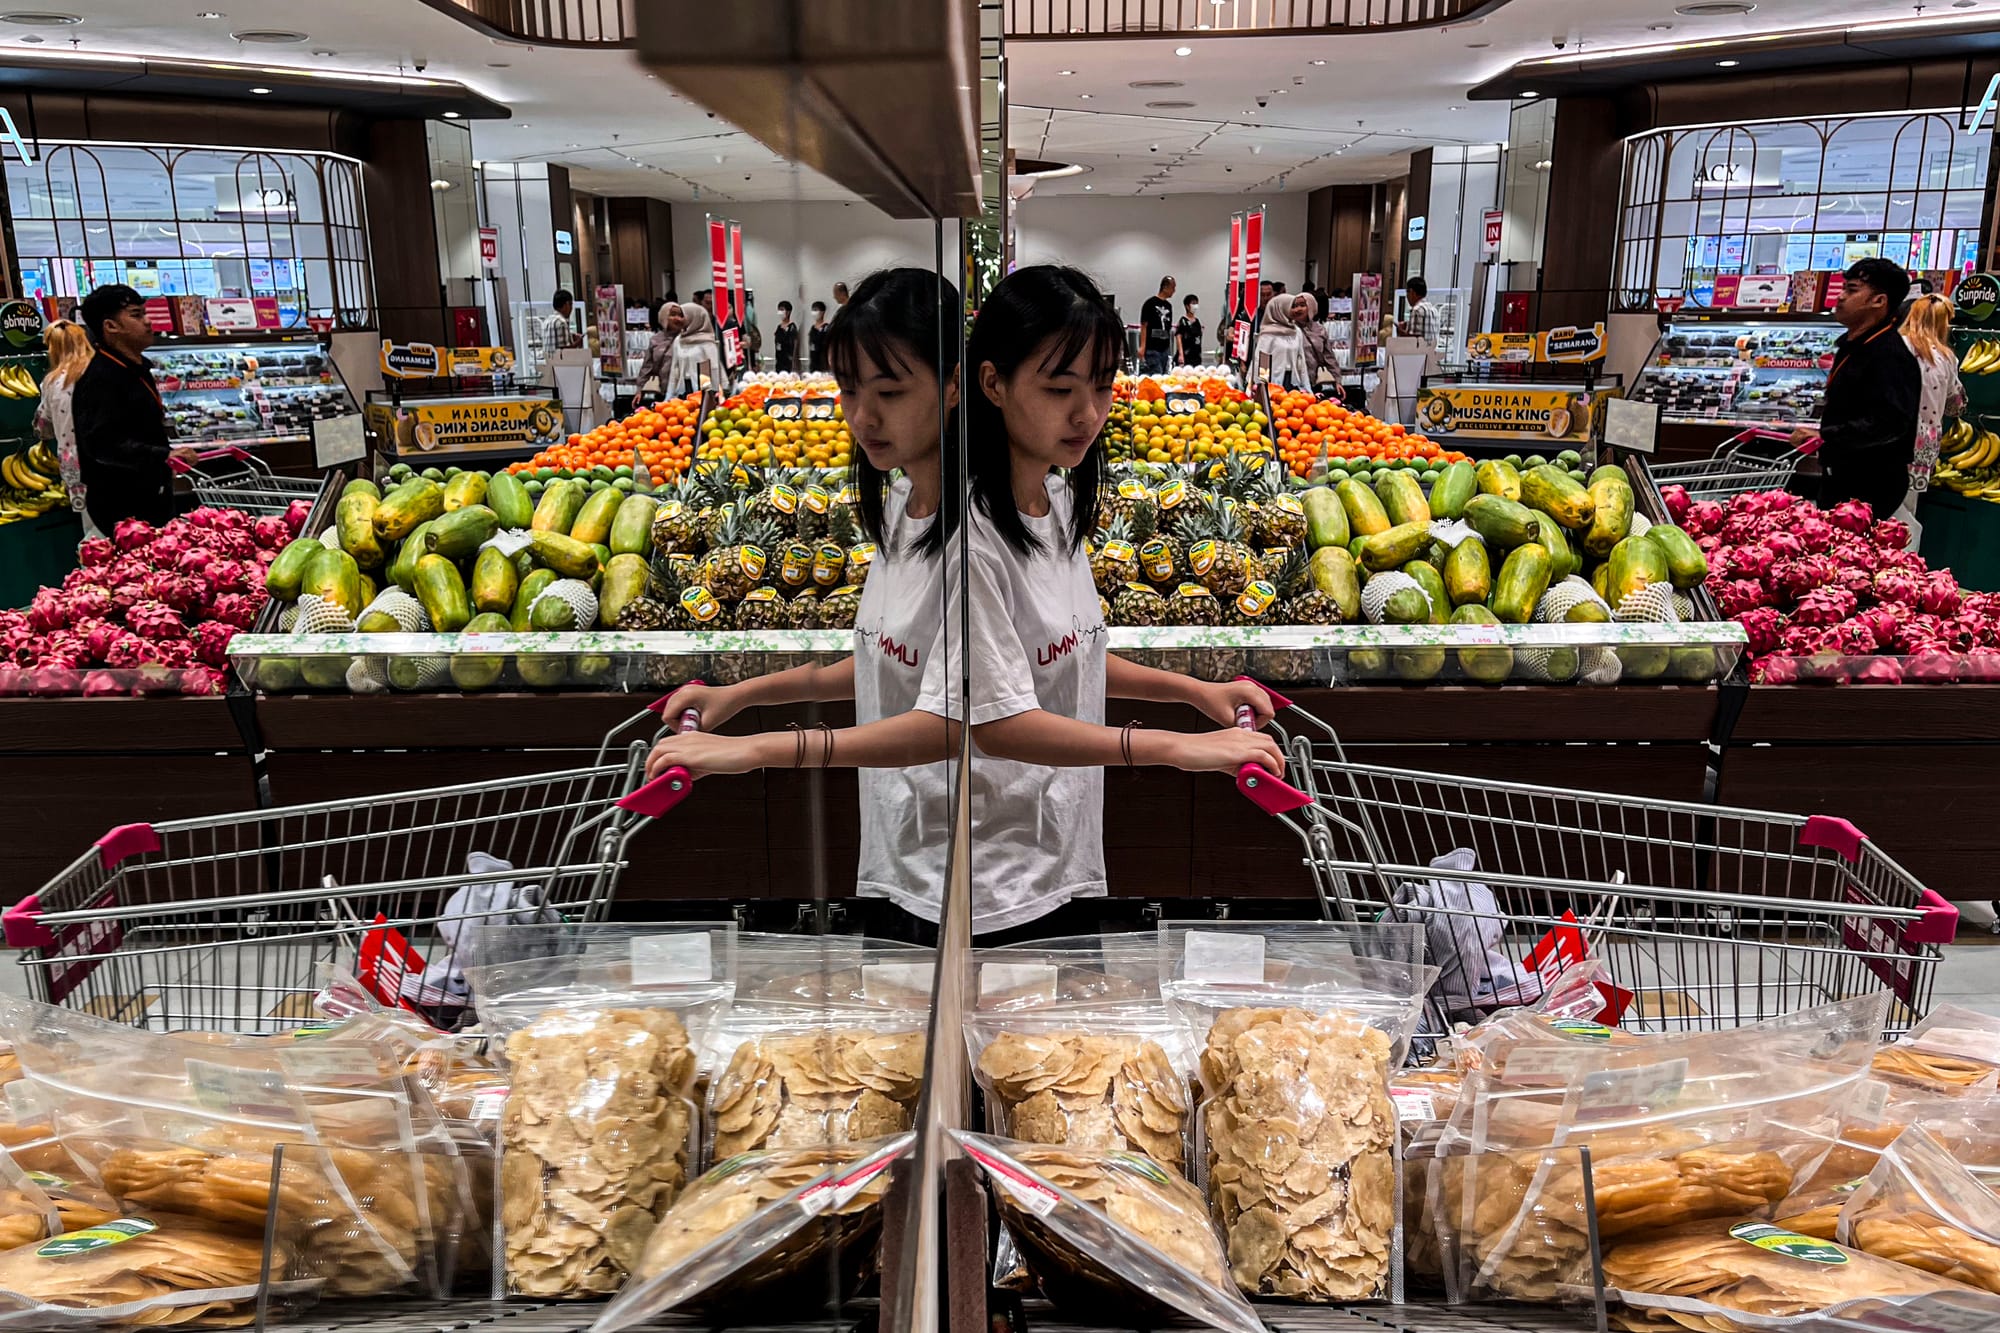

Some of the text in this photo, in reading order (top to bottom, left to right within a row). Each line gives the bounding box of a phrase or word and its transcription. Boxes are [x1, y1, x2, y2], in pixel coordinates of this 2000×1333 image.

[1488, 227, 1499, 239] IN
[1958, 287, 1996, 305] Sunpride
[1553, 338, 1597, 350] SEMARANG
[1473, 395, 1531, 406] DURIAN
[1453, 407, 1550, 421] MUSANG KING
[1459, 422, 1503, 430] EXCLUSIVE
[1037, 629, 1079, 666] UMM
